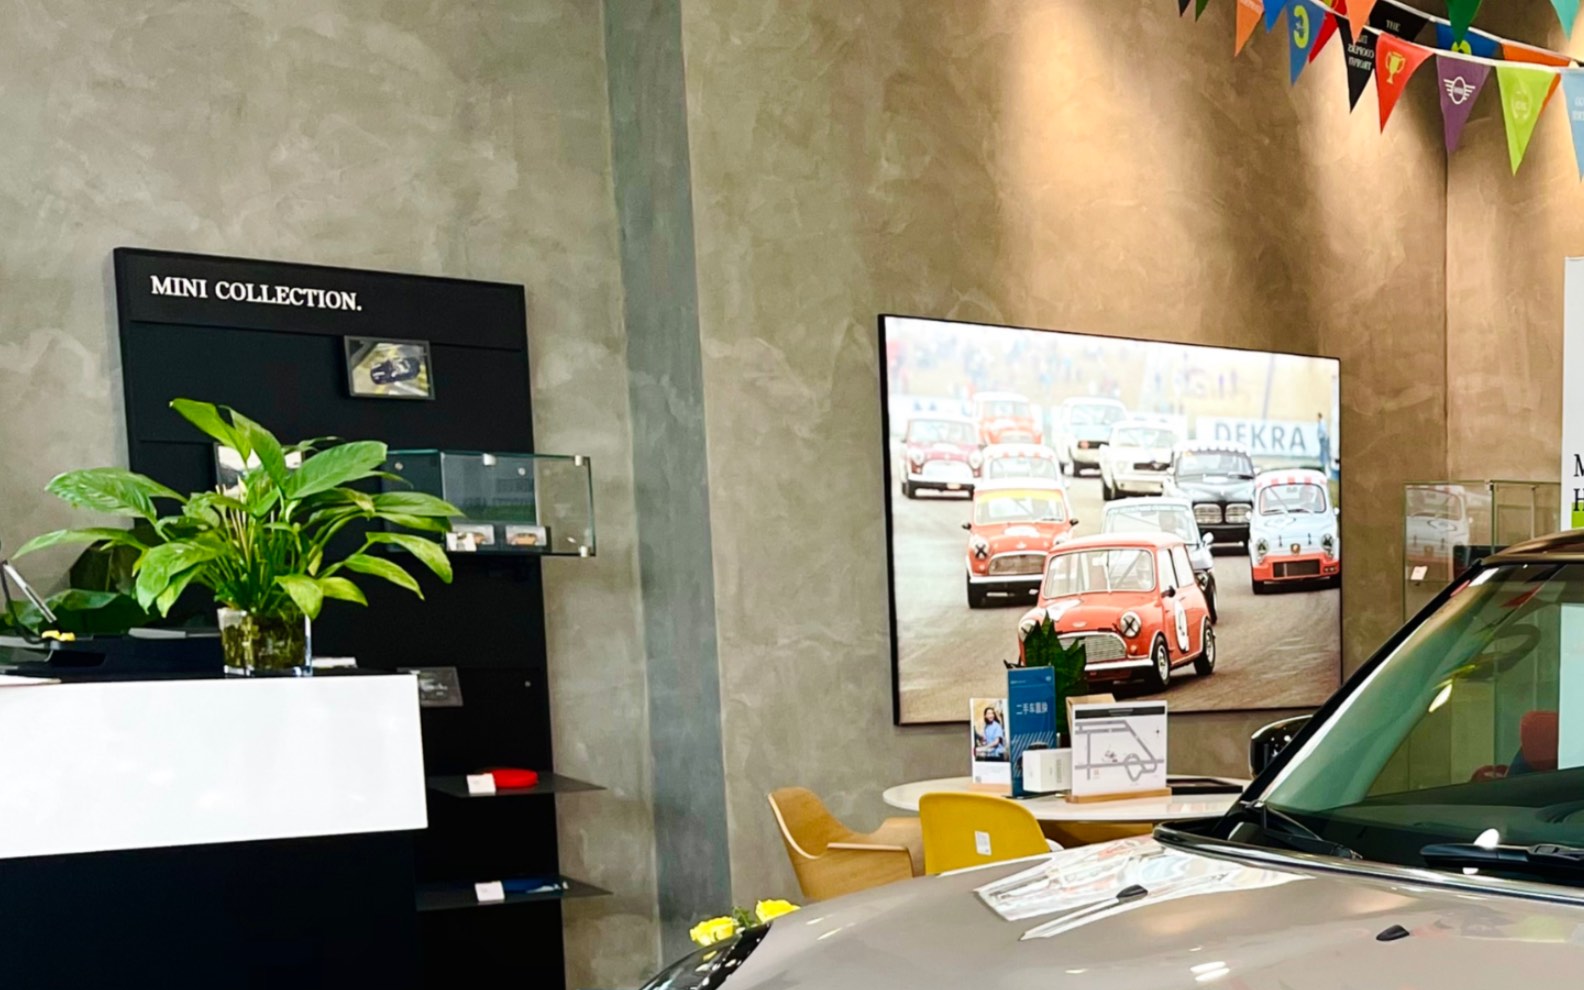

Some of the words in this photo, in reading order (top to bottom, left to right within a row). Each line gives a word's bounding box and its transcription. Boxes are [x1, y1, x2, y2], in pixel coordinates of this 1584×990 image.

[150, 275, 208, 299] MINI
[215, 281, 363, 312] COLLECTION.
[1215, 422, 1306, 451] DEKRA
